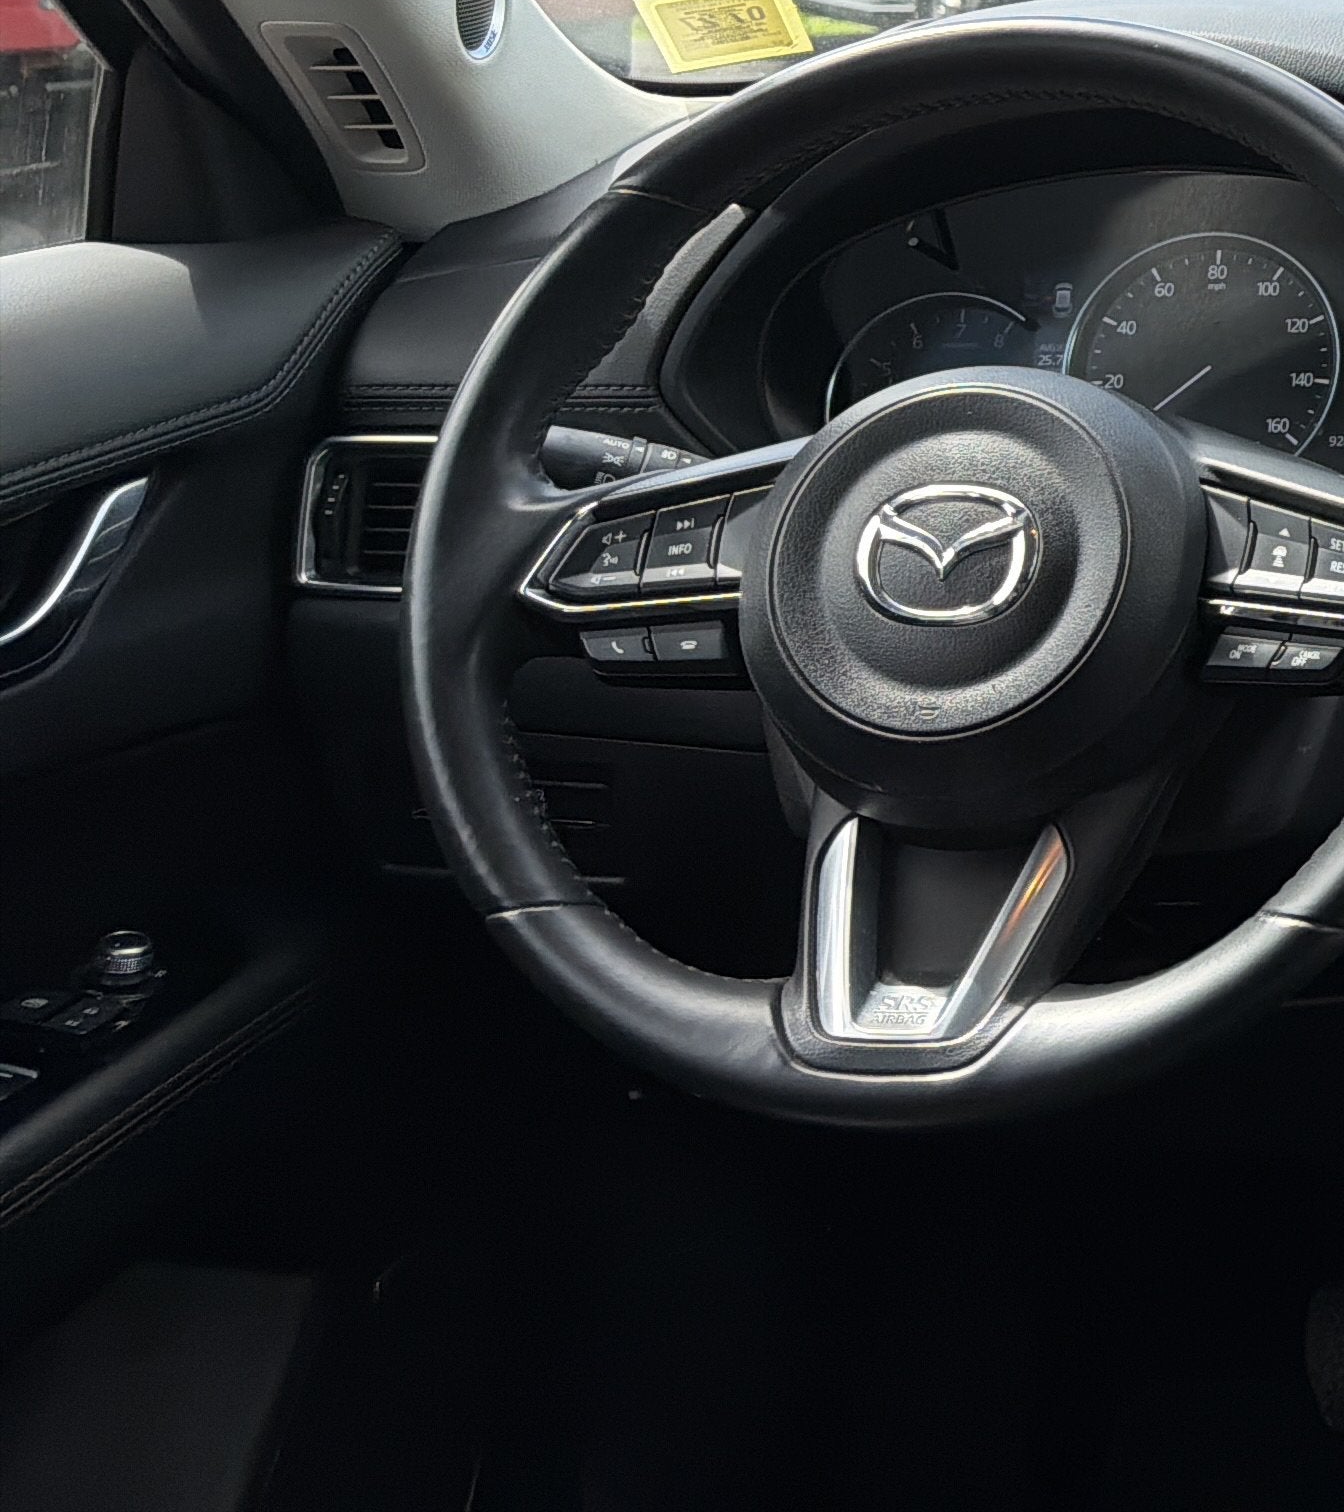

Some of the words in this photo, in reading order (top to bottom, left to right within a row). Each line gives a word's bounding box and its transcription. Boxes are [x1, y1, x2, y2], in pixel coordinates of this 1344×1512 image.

[1208, 266, 1227, 279] 80
[1154, 283, 1174, 297] 60
[1207, 283, 1226, 291] mph
[1257, 282, 1280, 296] 100
[1117, 321, 1137, 335] 40
[1285, 319, 1308, 333] 120
[1104, 374, 1124, 389] 20
[1290, 373, 1314, 387] 140
[1266, 418, 1290, 433] 160
[603, 439, 631, 450] AUTO
[668, 543, 693, 556] INFO
[1229, 650, 1242, 659] ON
[1291, 657, 1308, 667] OFF
[881, 995, 929, 1011] SRS
[871, 1014, 927, 1025] AIRBAG
